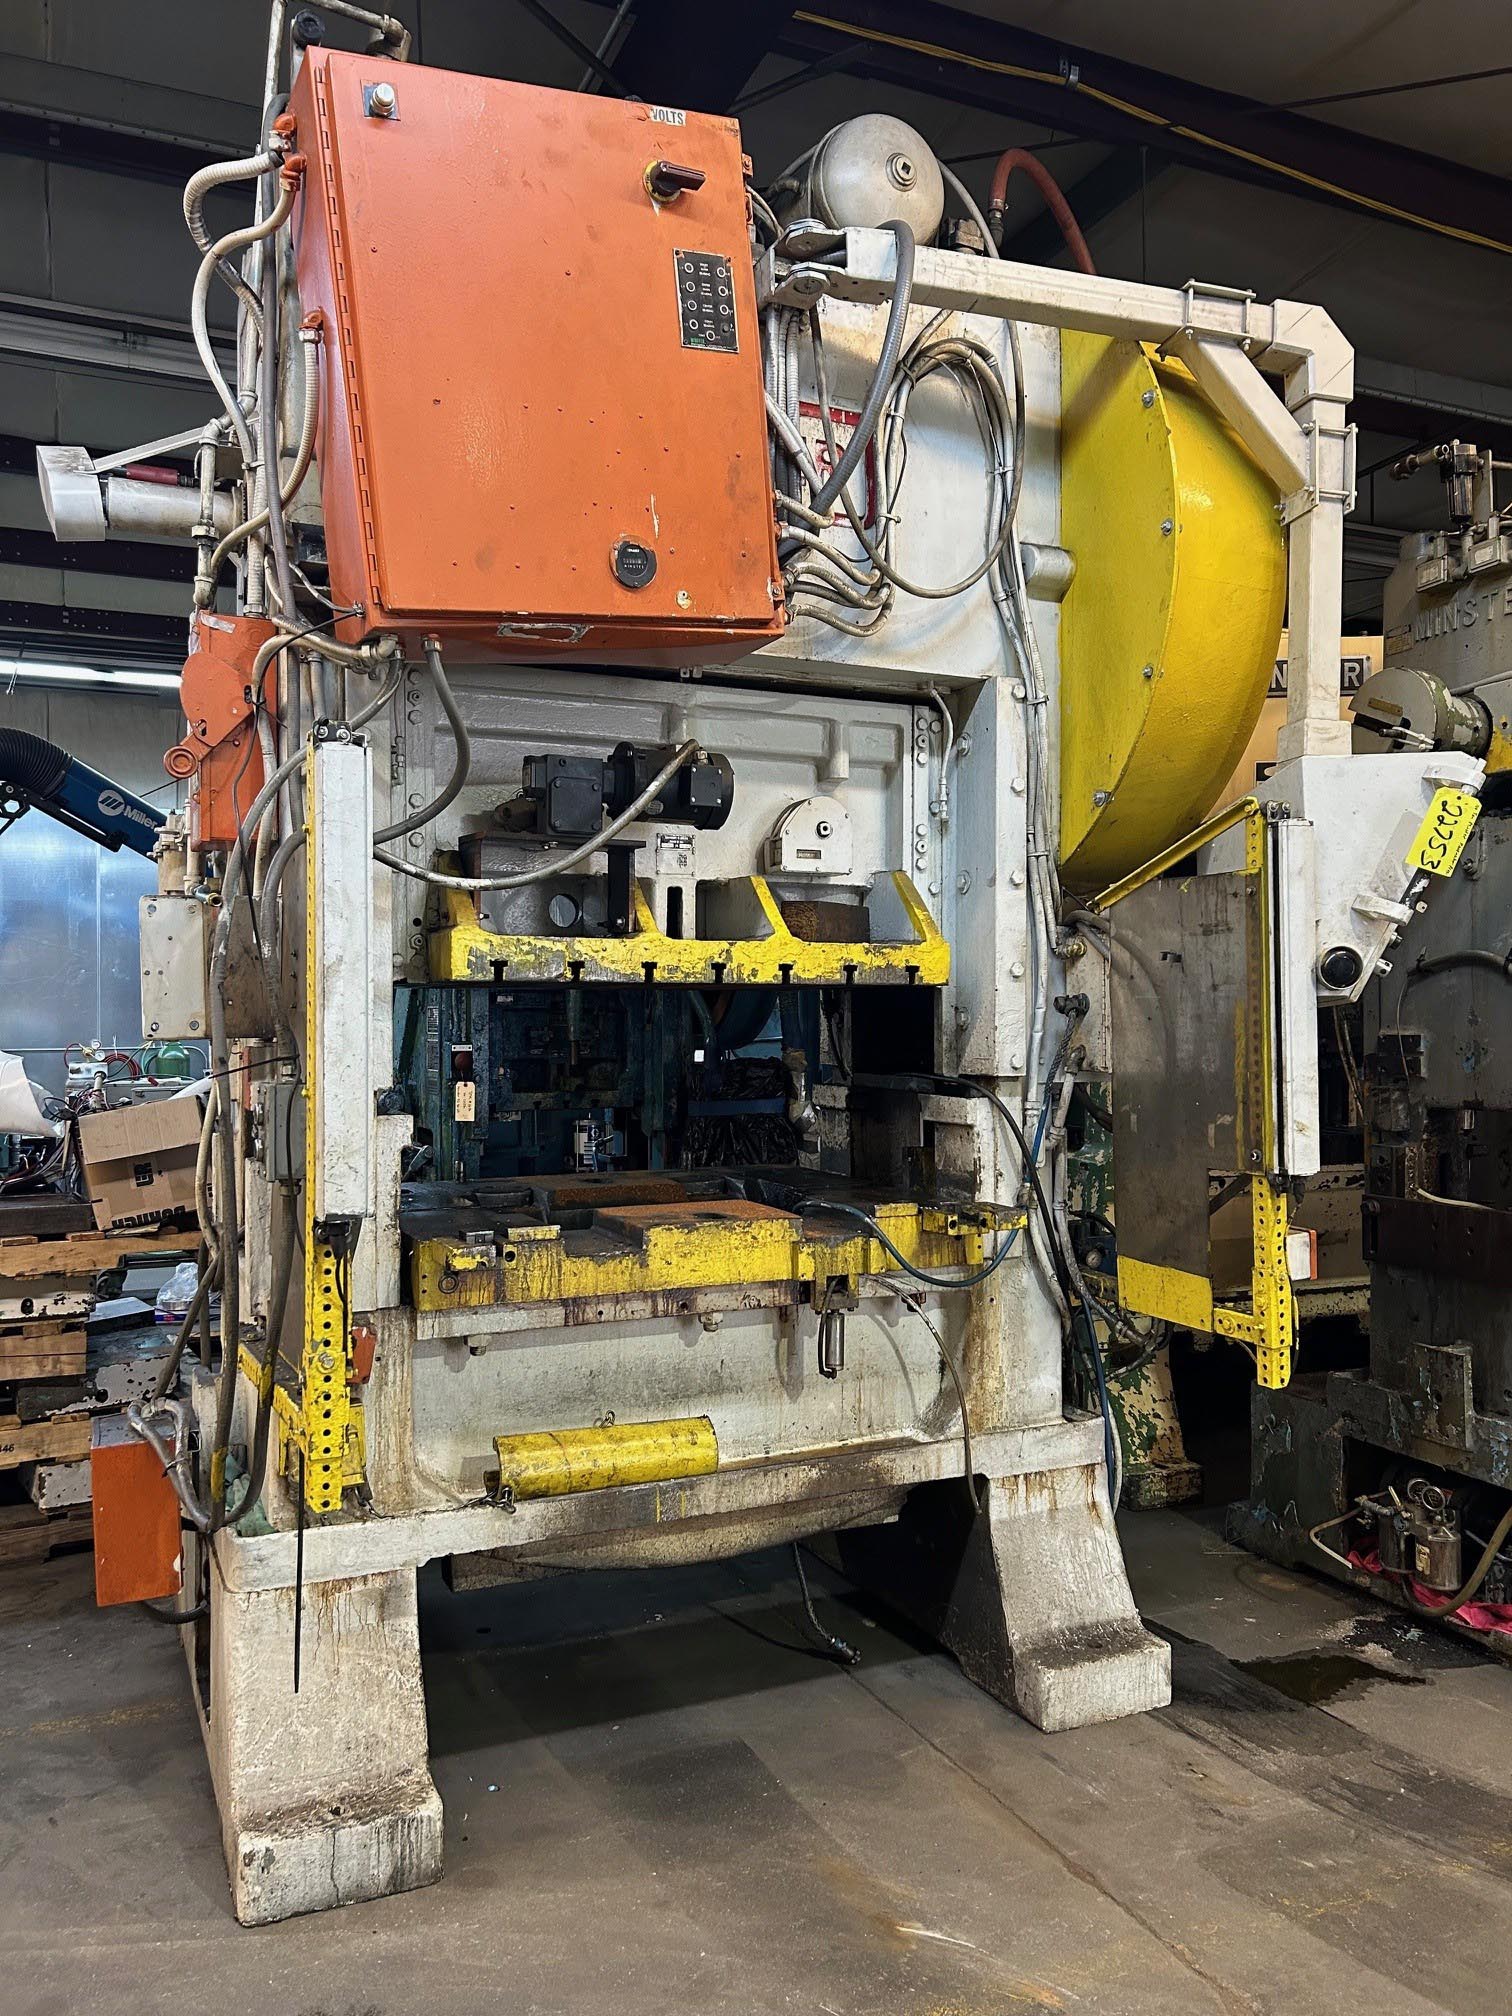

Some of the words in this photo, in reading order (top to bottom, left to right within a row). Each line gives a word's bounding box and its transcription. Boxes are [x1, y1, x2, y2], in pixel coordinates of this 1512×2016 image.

[650, 108, 685, 125] VOLTS
[123, 805, 158, 830] Miller
[1420, 800, 1463, 870] 22753
